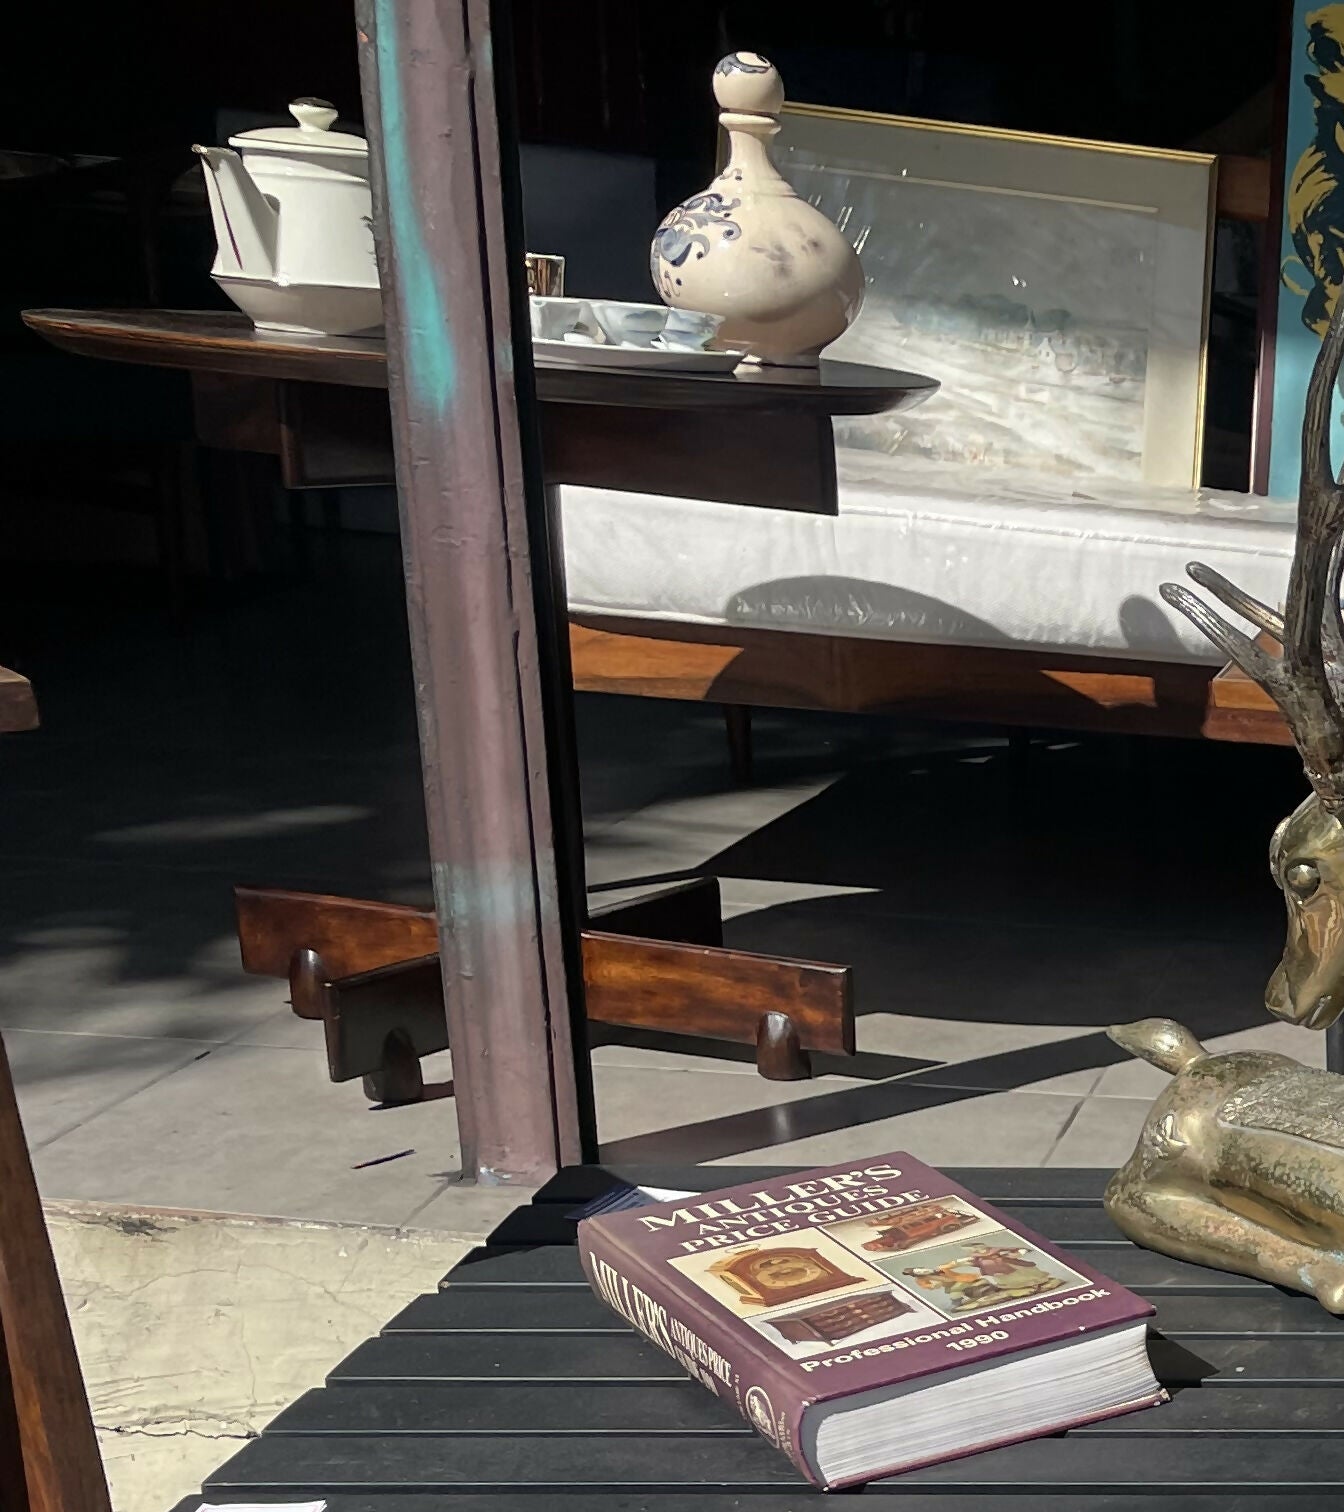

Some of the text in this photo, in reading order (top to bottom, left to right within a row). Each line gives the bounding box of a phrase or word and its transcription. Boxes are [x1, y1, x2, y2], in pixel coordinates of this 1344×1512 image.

[638, 1164, 902, 1232] MILLER'S
[679, 1189, 930, 1252] PRICE GUIDE
[699, 1185, 889, 1235] ANTIQUES
[589, 1251, 677, 1360] MILLER'S
[799, 1286, 1111, 1373] Professional Handbook
[946, 1330, 1010, 1352] 1990
